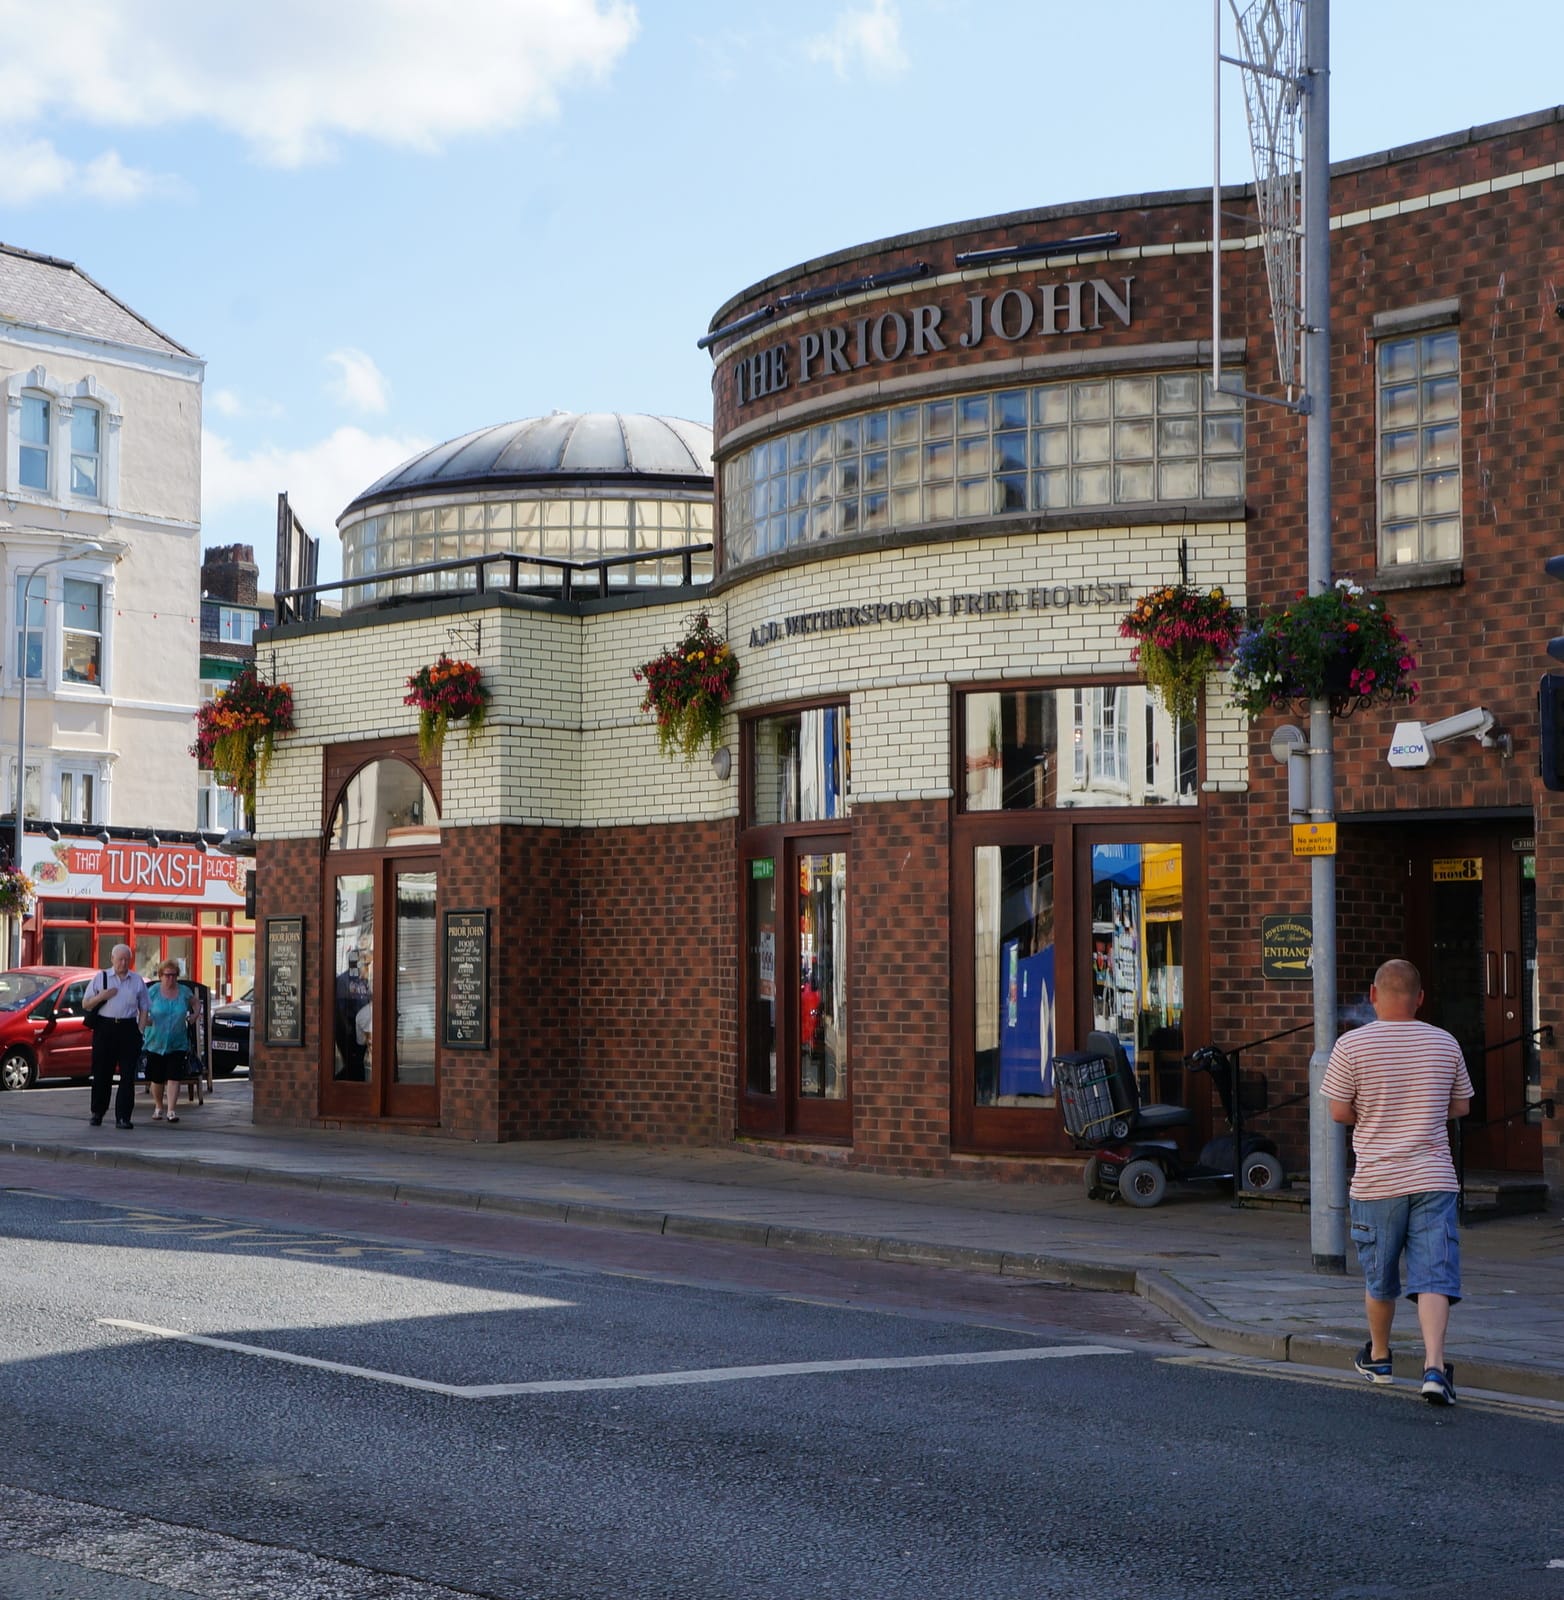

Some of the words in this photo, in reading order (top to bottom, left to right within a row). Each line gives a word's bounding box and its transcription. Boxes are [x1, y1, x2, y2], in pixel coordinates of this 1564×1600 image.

[733, 343, 790, 408] THE
[799, 304, 946, 383] PRIOR
[961, 276, 1136, 348] JOHN
[784, 596, 942, 637] WETHERSPOON
[948, 589, 1020, 617] FREE
[1026, 583, 1132, 609] HOUSE
[1392, 744, 1424, 755] SECOM
[75, 851, 101, 871] THAT
[107, 849, 203, 888] TURKISH
[206, 859, 235, 878] PLACE
[1462, 859, 1477, 878] 8
[448, 926, 466, 937] PRIOR
[466, 926, 484, 938] JOHN
